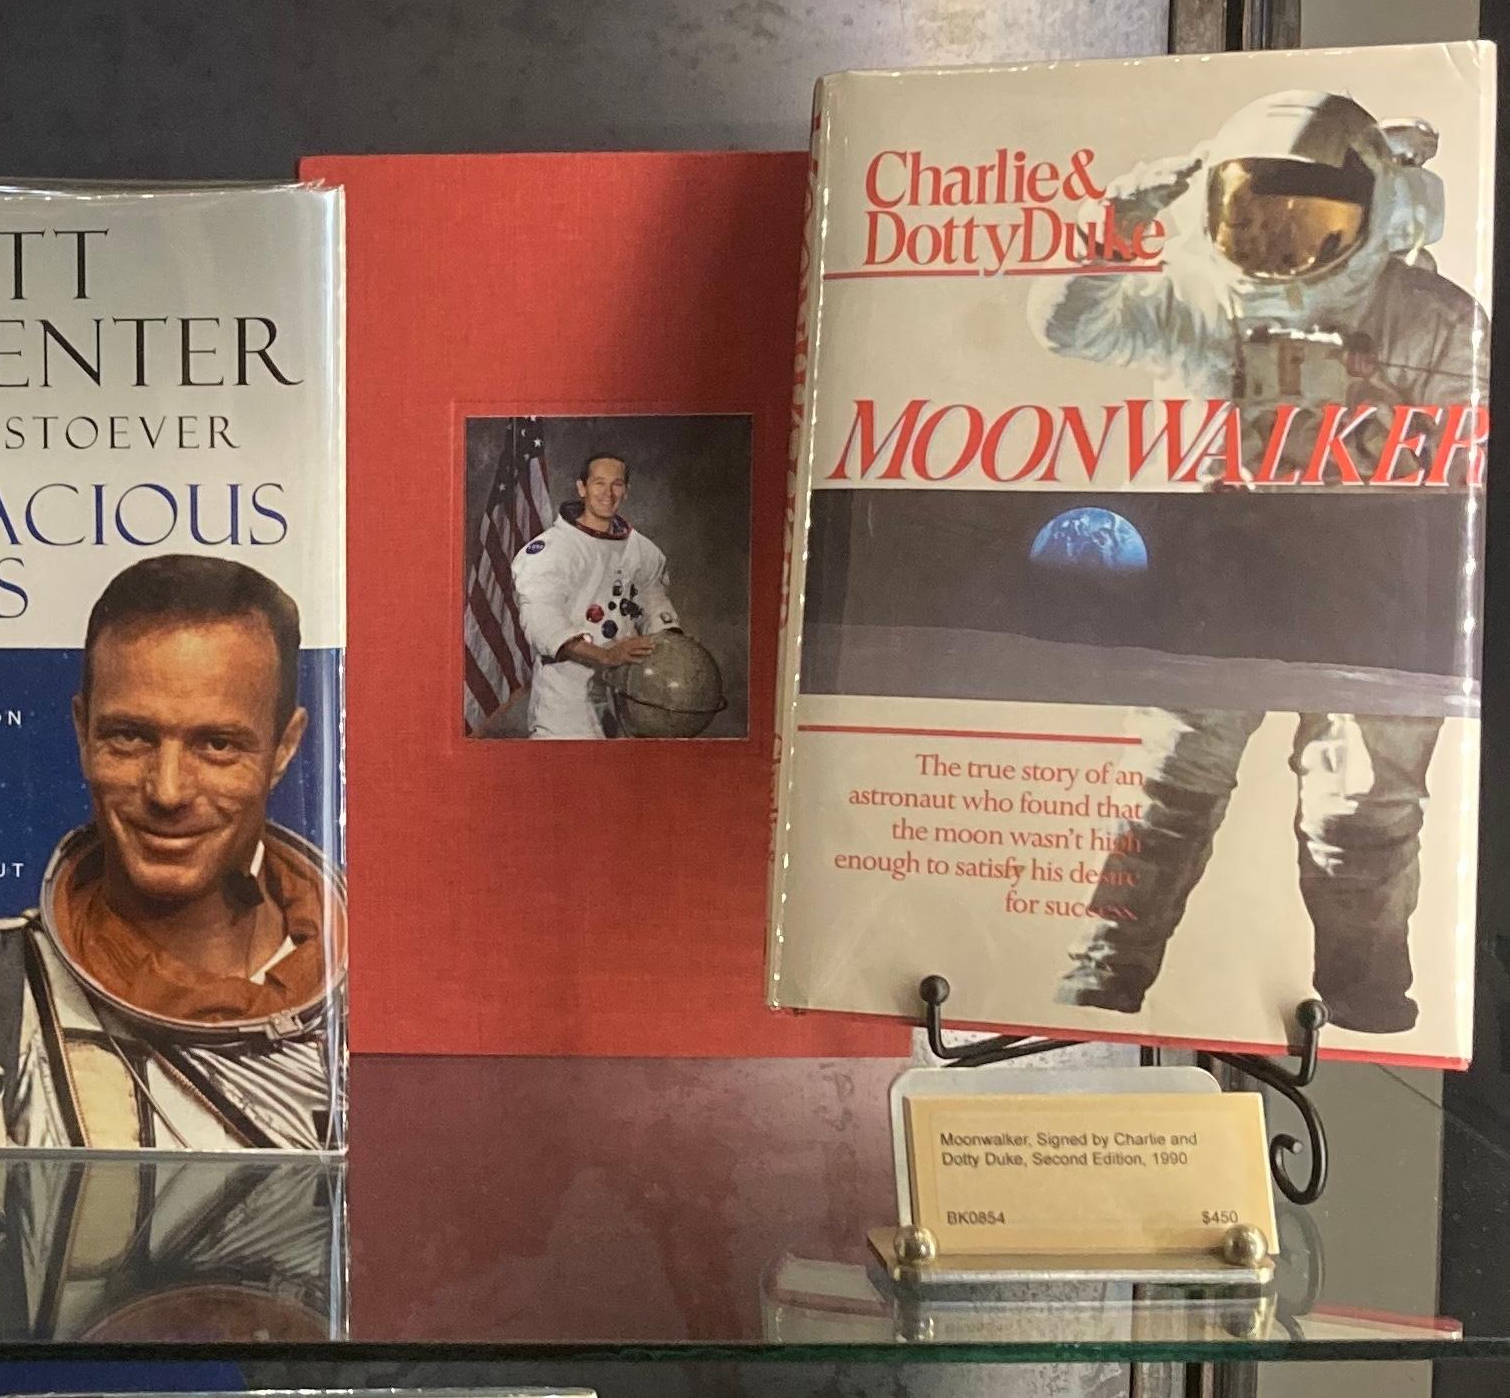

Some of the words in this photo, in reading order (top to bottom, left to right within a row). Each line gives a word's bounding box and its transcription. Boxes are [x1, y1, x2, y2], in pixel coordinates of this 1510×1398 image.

[5, 415, 241, 450] STOEVER
[828, 399, 1492, 490] MOONWALKER
[967, 761, 1016, 780] true
[1021, 762, 1079, 791] story
[848, 788, 956, 810] astronaut
[1019, 794, 1090, 819] found
[1097, 799, 1141, 820] that
[935, 826, 1003, 846] moon
[1010, 828, 1083, 851] wasn't
[834, 851, 920, 881] enough
[955, 857, 1026, 887] satisfy
[940, 1132, 1032, 1147] Moonwalker,
[1037, 1132, 1088, 1148] Signed
[1114, 1132, 1166, 1146] Charlie
[942, 1152, 979, 1168] Dotty
[986, 1153, 1028, 1166] Duke,
[1033, 1151, 1088, 1166] Second
[1093, 1153, 1147, 1167] Edition,
[1153, 1151, 1188, 1166] 1990
[947, 1211, 1005, 1225] BK0854
[1201, 1210, 1239, 1224] $450
